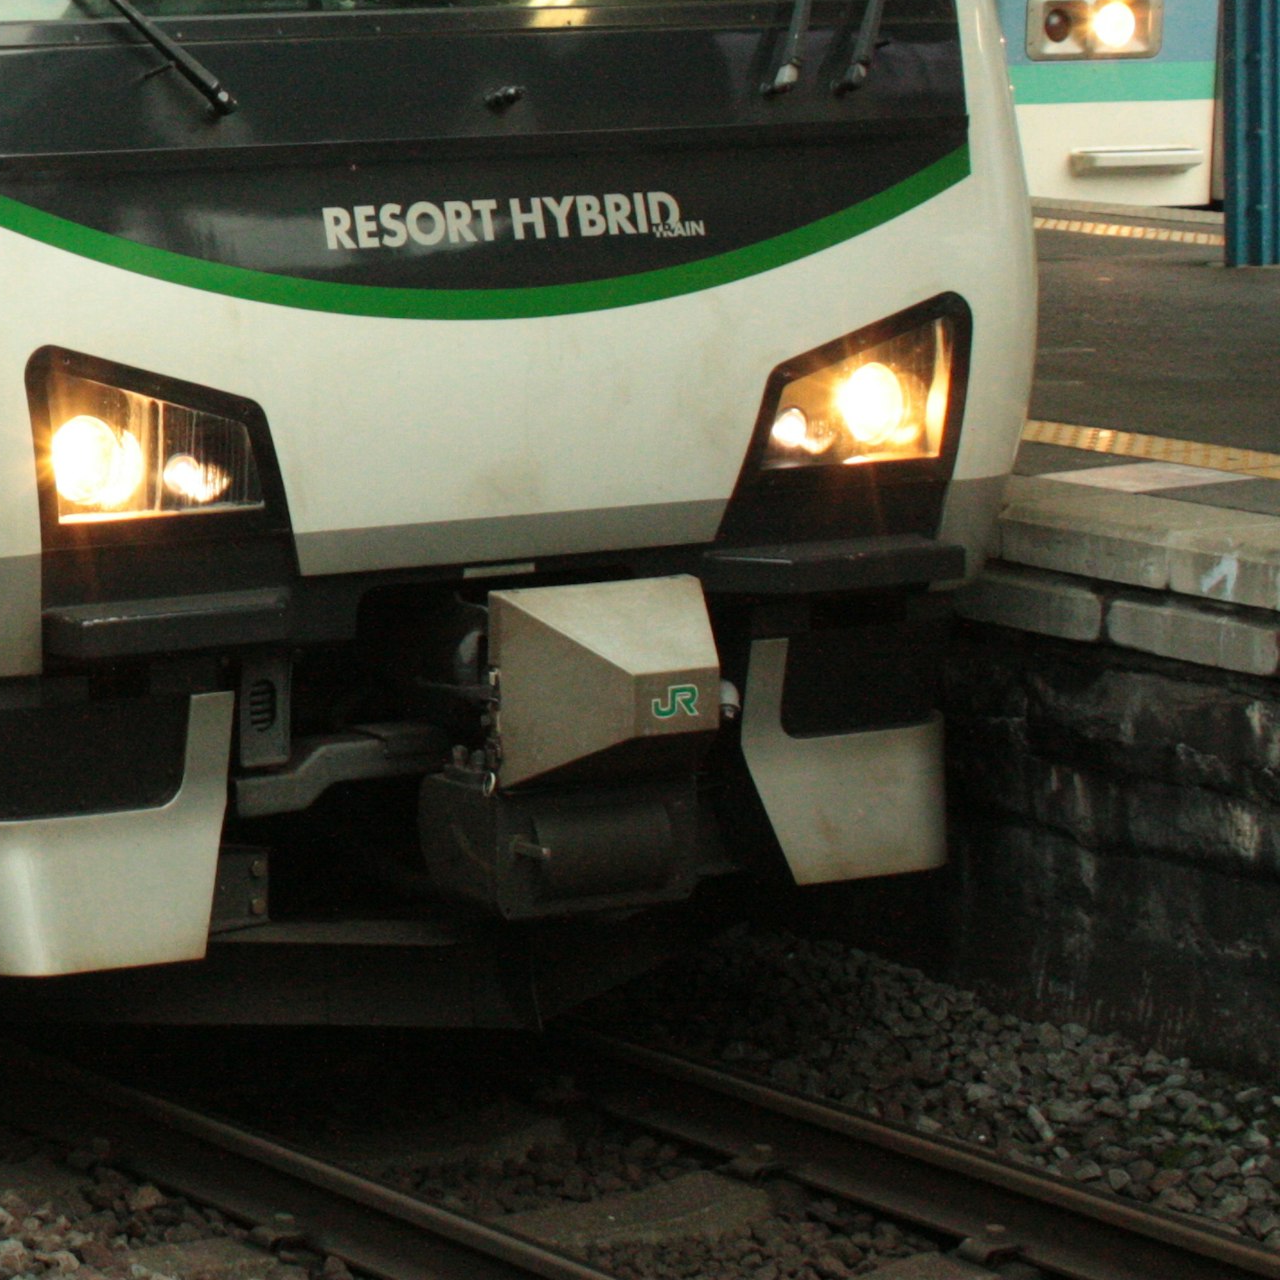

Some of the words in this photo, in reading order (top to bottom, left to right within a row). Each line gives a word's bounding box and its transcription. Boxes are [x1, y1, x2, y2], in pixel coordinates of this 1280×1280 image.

[322, 199, 498, 250] RESORT
[509, 191, 680, 241] HYBRID
[652, 220, 706, 238] TRAIN
[652, 684, 698, 718] JR
